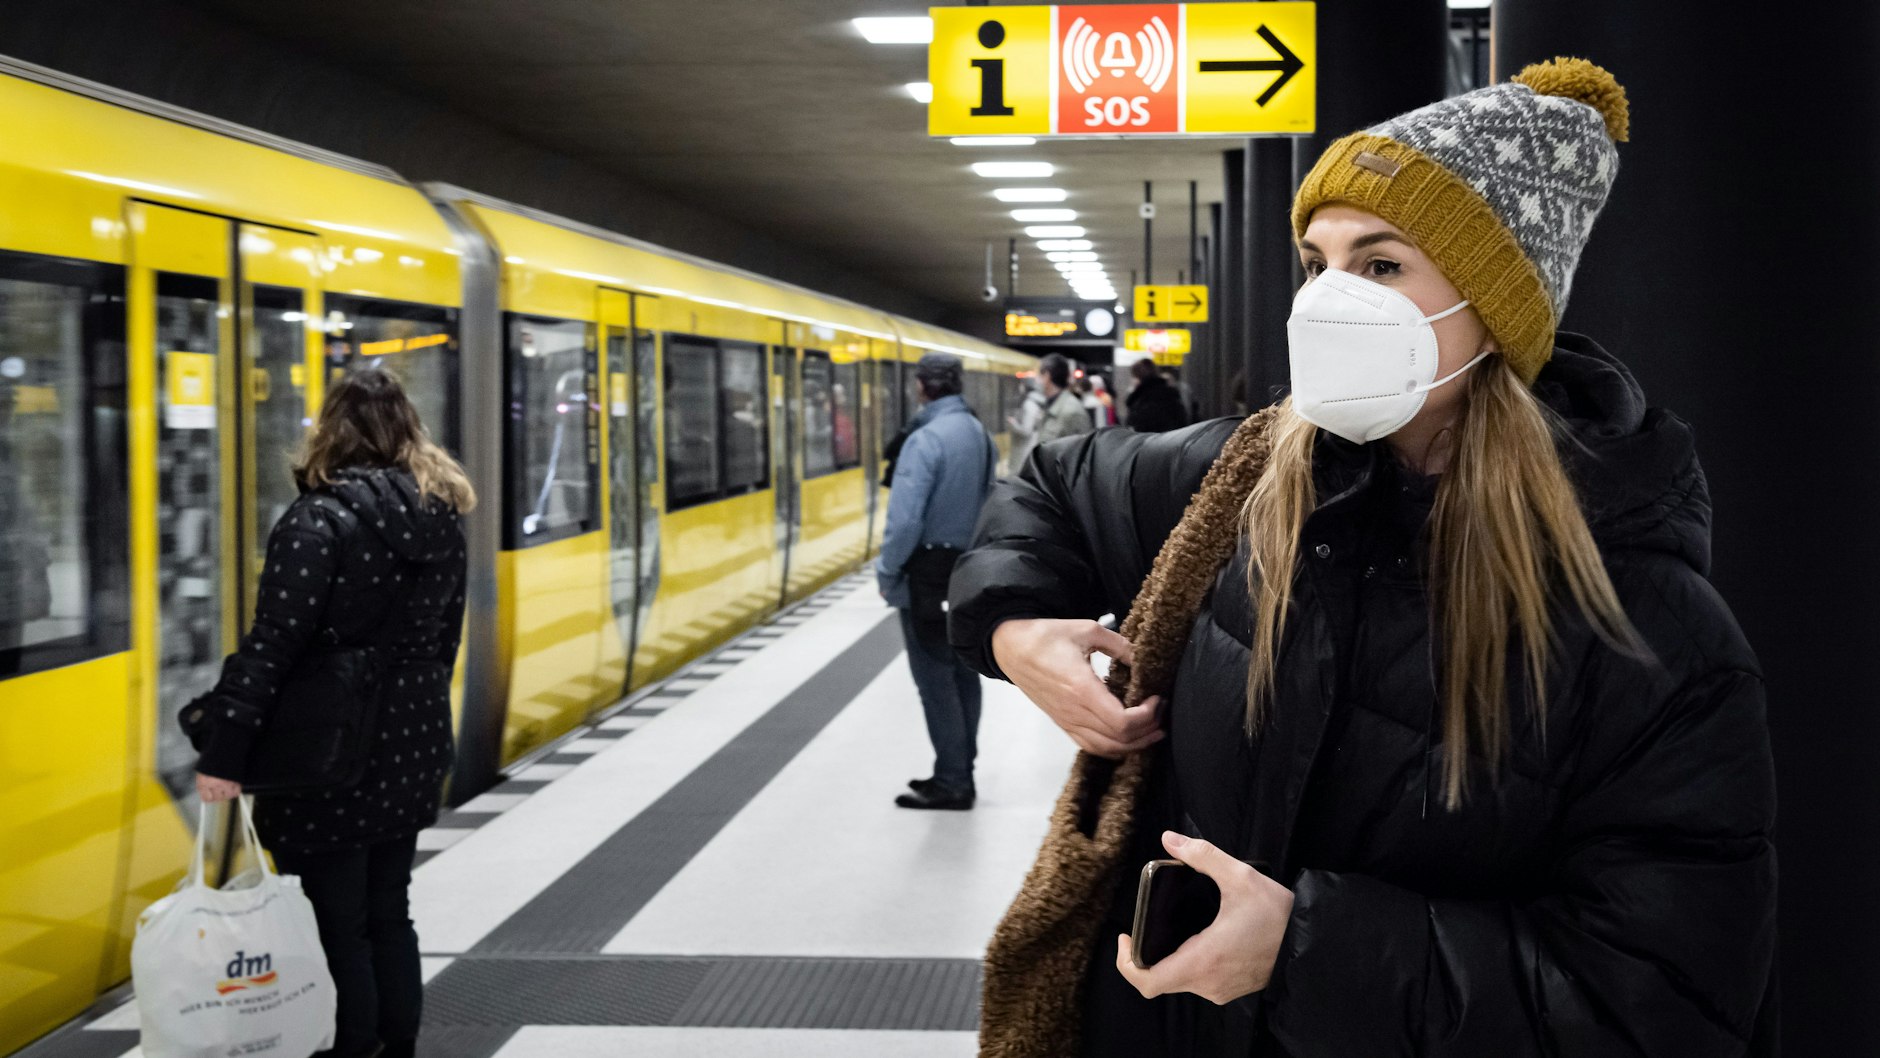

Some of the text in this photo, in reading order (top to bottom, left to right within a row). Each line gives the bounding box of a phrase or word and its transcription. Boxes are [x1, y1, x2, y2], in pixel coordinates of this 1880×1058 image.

[970, 20, 1014, 116] i
[1084, 96, 1150, 126] SOS
[226, 949, 272, 979] dm
